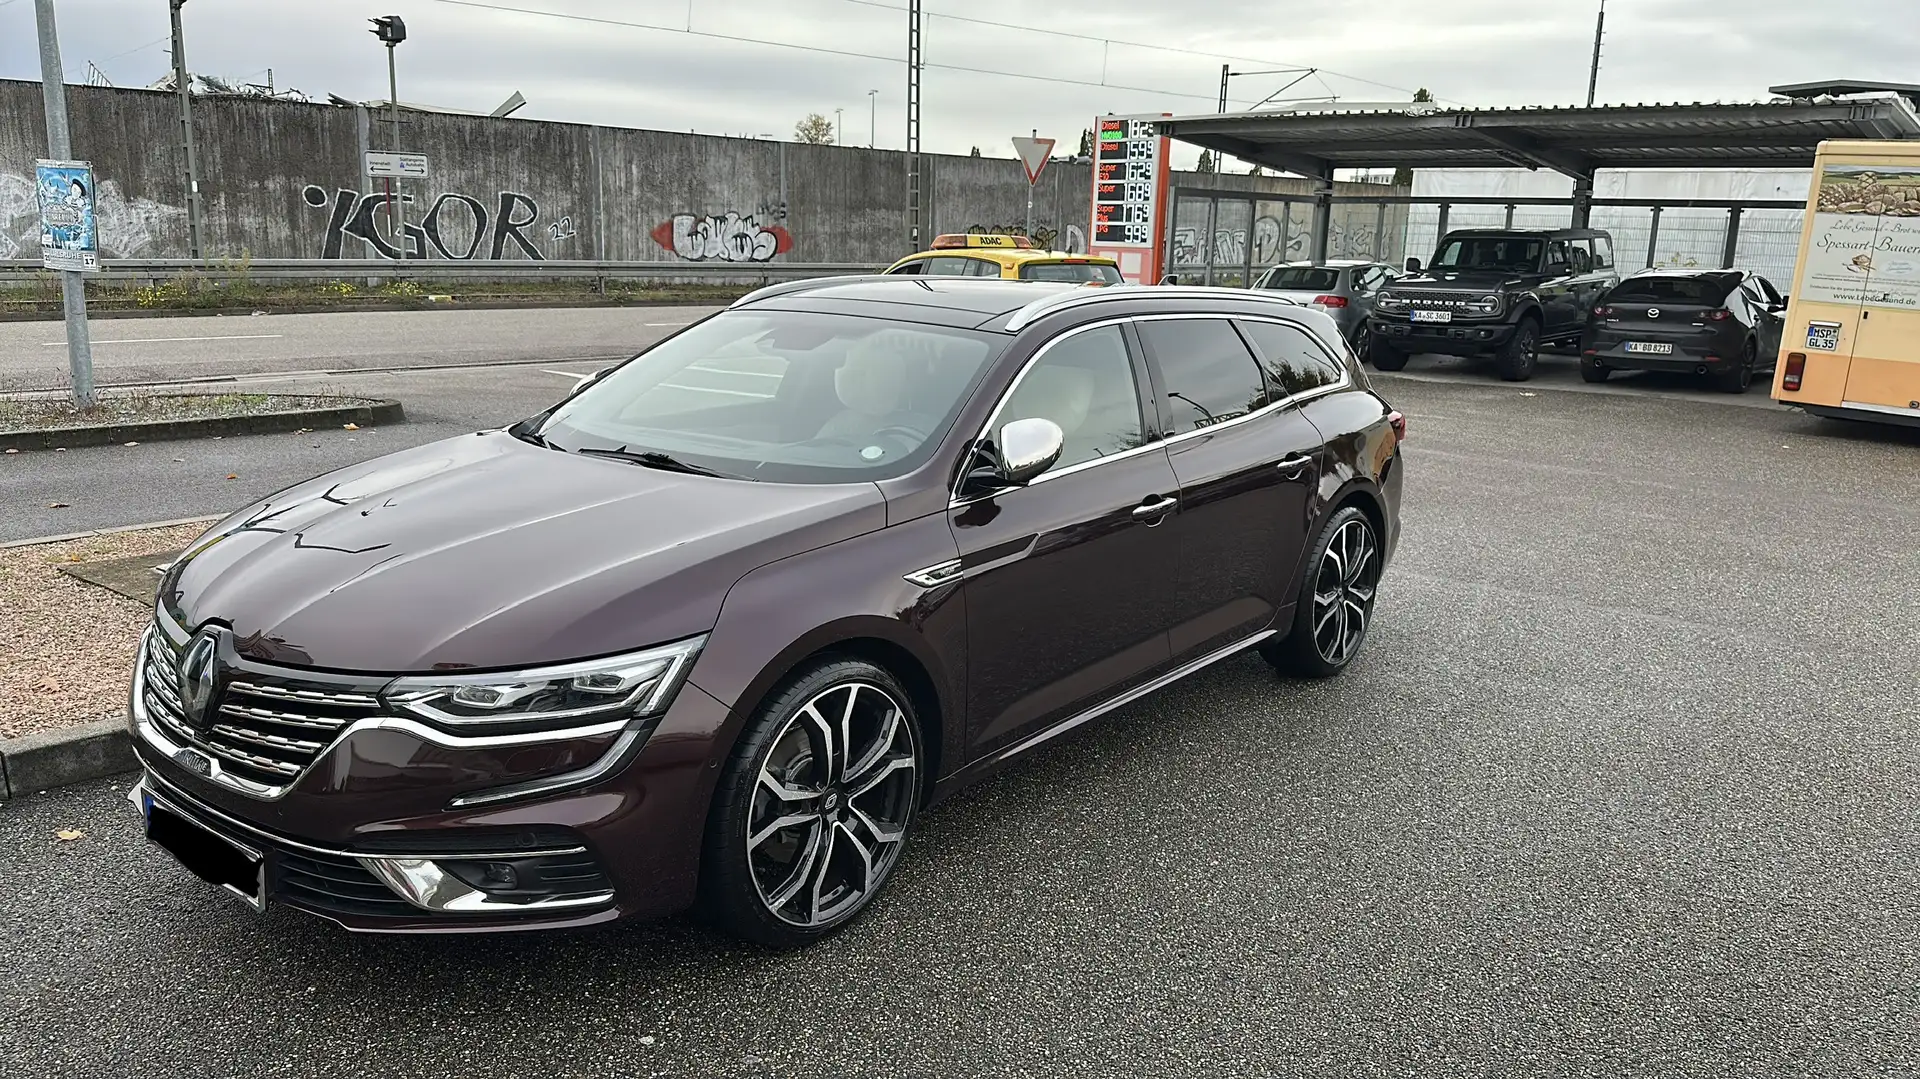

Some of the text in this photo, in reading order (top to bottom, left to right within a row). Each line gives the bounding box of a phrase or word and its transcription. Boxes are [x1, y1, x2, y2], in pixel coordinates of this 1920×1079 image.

[1101, 121, 1120, 130] Diesel
[1100, 142, 1118, 151] Diesel
[1100, 164, 1116, 172] Super
[1098, 184, 1115, 193] Super
[1097, 205, 1114, 213] Super
[1096, 214, 1109, 222] Plus
[548, 216, 577, 241] 22
[1096, 225, 1108, 233] LPG
[1890, 222, 1910, 233] Brot
[980, 236, 1002, 246] ADAC
[1414, 310, 1422, 319] KA
[1814, 328, 1832, 339] MSP
[1629, 342, 1639, 351] KA
[1809, 338, 1834, 349] GL 35
